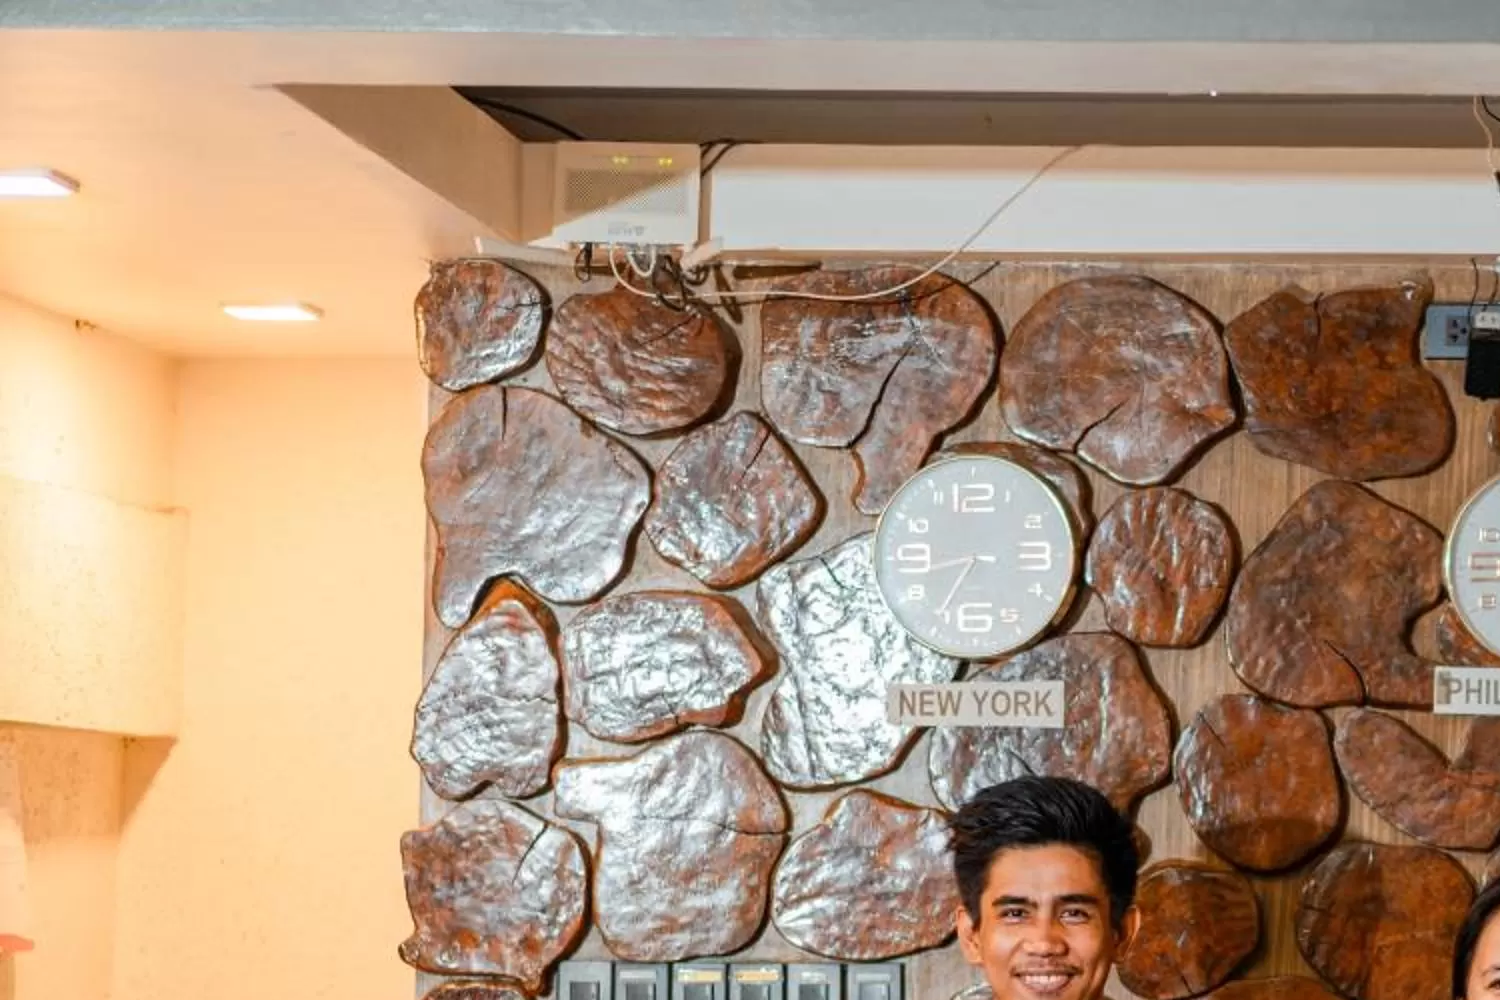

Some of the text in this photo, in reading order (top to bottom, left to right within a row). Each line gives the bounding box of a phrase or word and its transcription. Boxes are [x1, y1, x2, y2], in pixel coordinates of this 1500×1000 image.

[952, 483, 996, 513] 12
[907, 518, 929, 533] 10
[1024, 513, 1043, 530] 2
[897, 544, 931, 573] 9
[1016, 541, 1051, 571] 3
[908, 583, 925, 600] 8
[1028, 582, 1043, 598] 4
[956, 603, 993, 633] 6
[1000, 607, 1020, 623] 5
[899, 689, 1055, 718] NEW YORK
